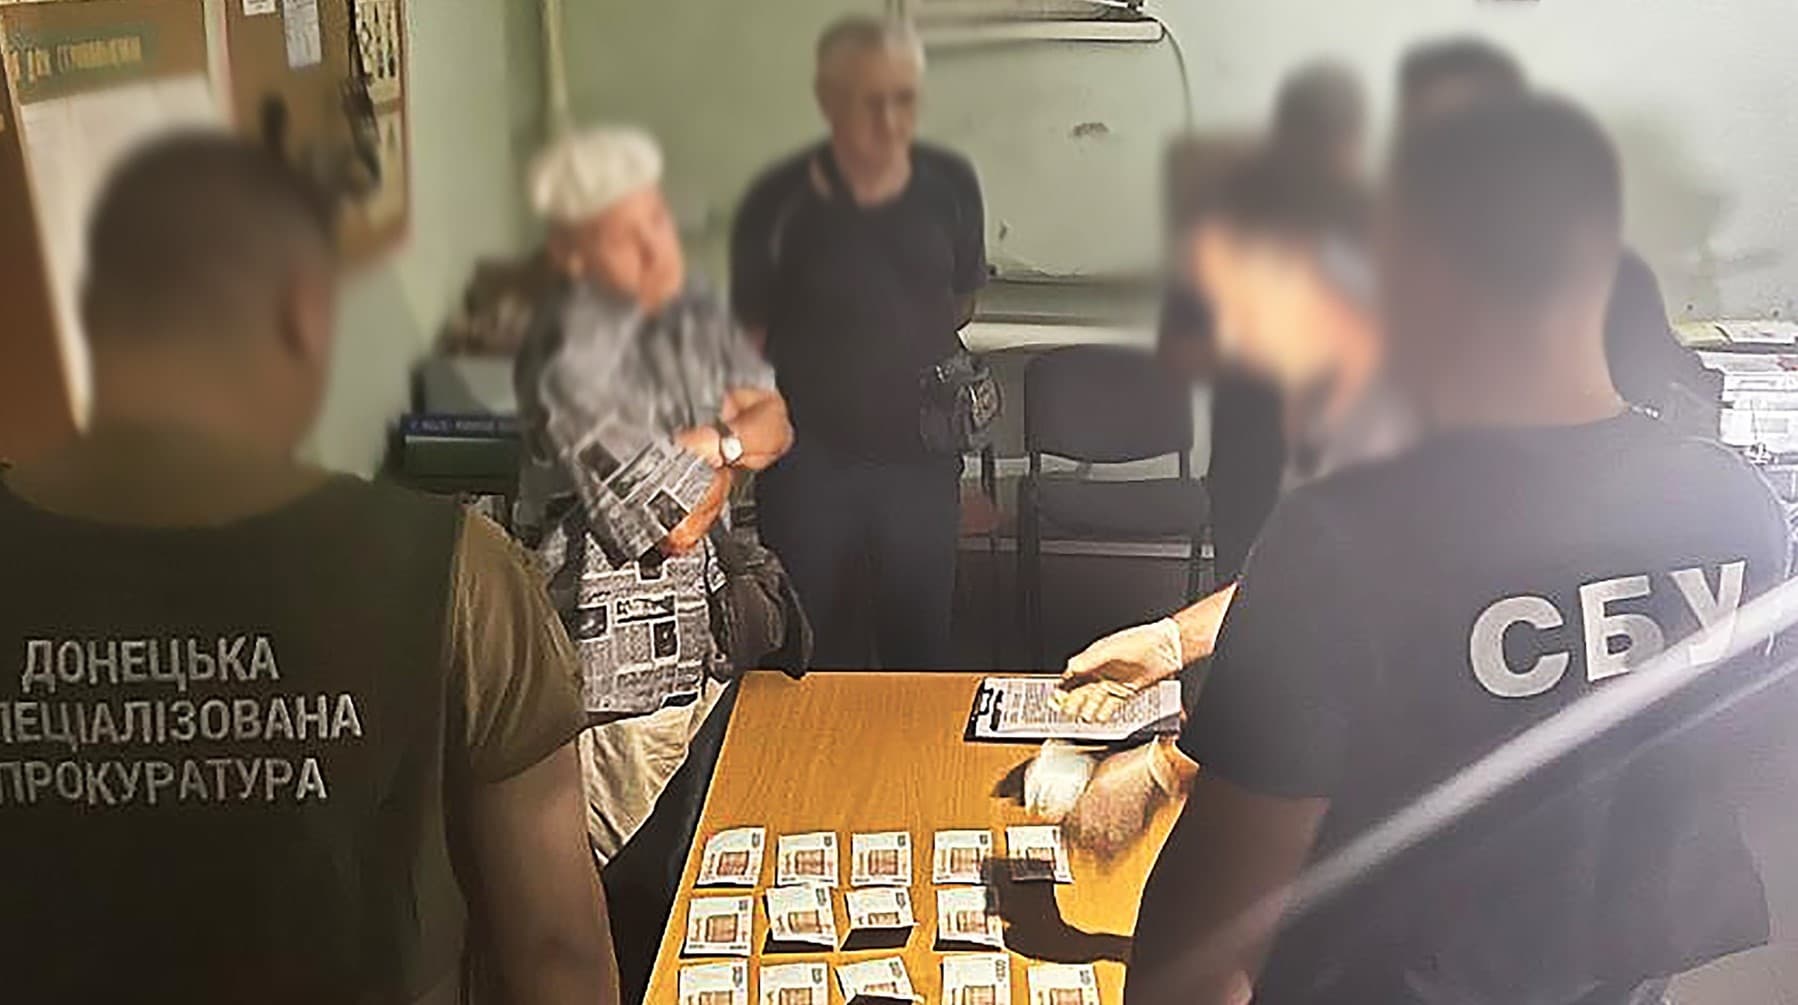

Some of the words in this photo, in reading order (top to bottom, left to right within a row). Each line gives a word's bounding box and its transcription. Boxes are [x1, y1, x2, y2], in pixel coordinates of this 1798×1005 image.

[1470, 560, 1746, 698] СБУ
[22, 636, 280, 693] ДОНЕЦЬКА
[0, 758, 328, 805] ПРОКУРАТУРА
